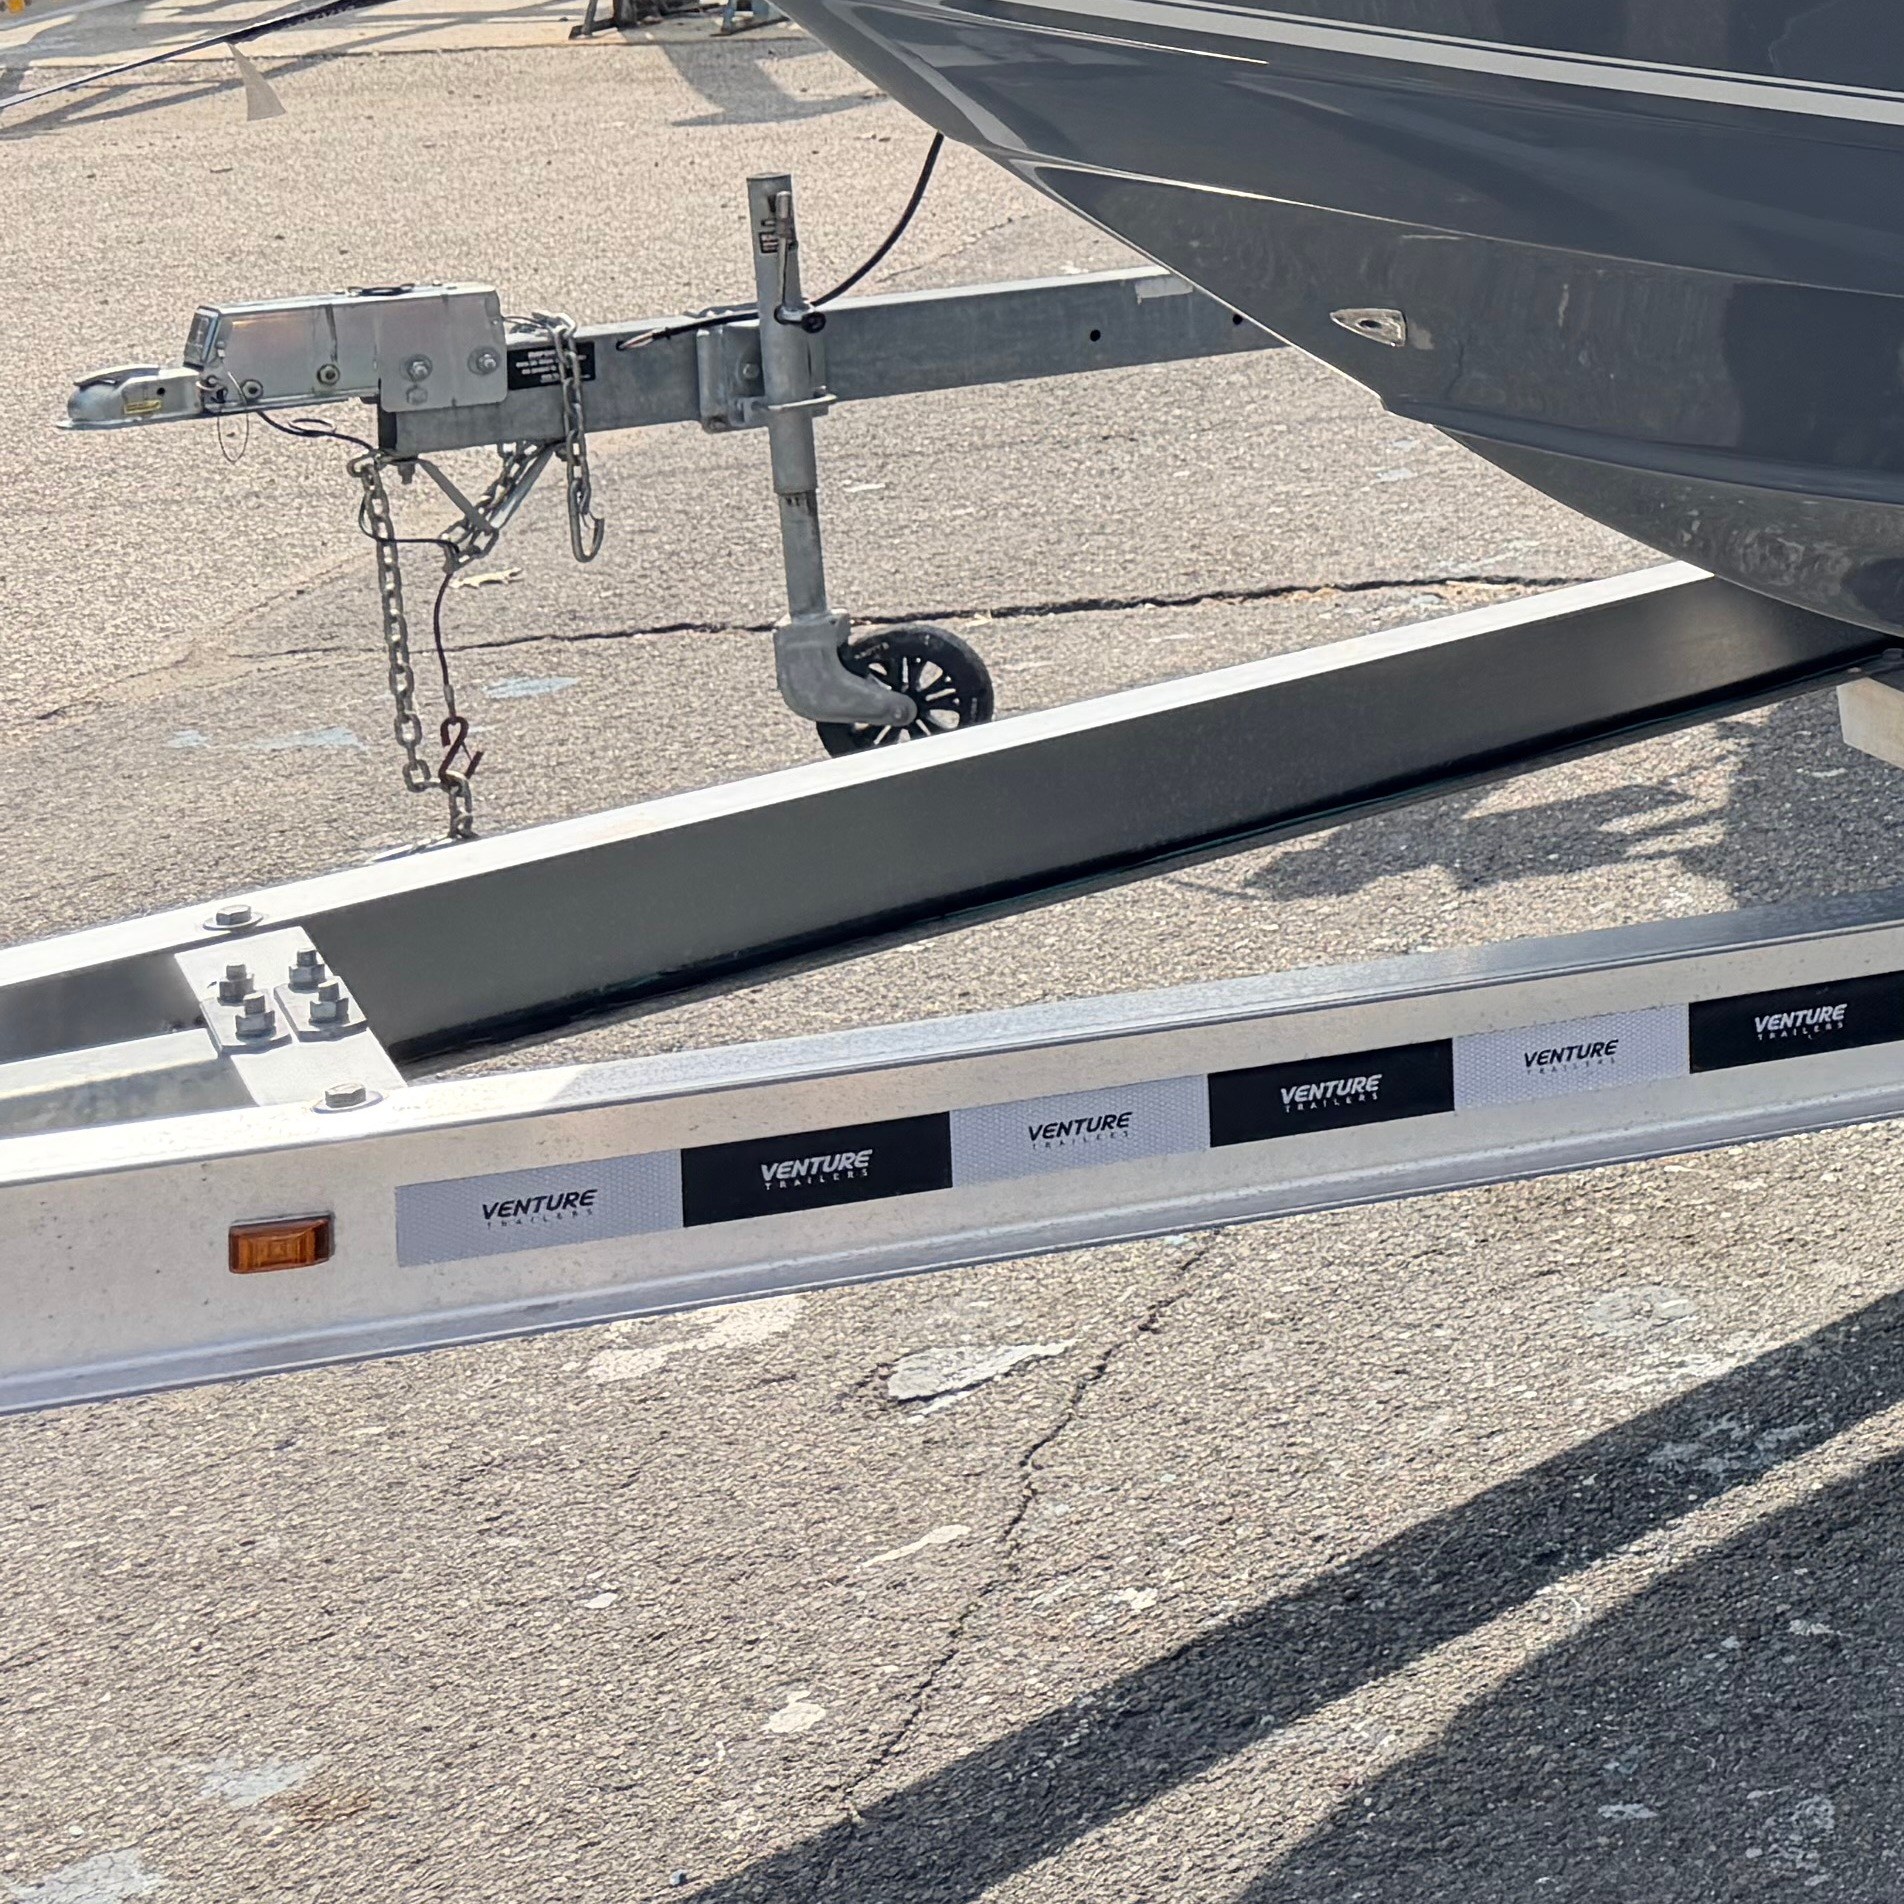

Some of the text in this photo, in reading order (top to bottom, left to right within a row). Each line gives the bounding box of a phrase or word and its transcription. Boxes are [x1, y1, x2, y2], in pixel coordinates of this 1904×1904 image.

[1754, 1003, 1848, 1033] VENTURE
[1524, 1039, 1619, 1068] VENTURE
[1280, 1073, 1383, 1105] VENTURE
[1028, 1111, 1133, 1142] VENTURE
[760, 1149, 873, 1182] VENTURE
[482, 1188, 599, 1220] VENTURE
